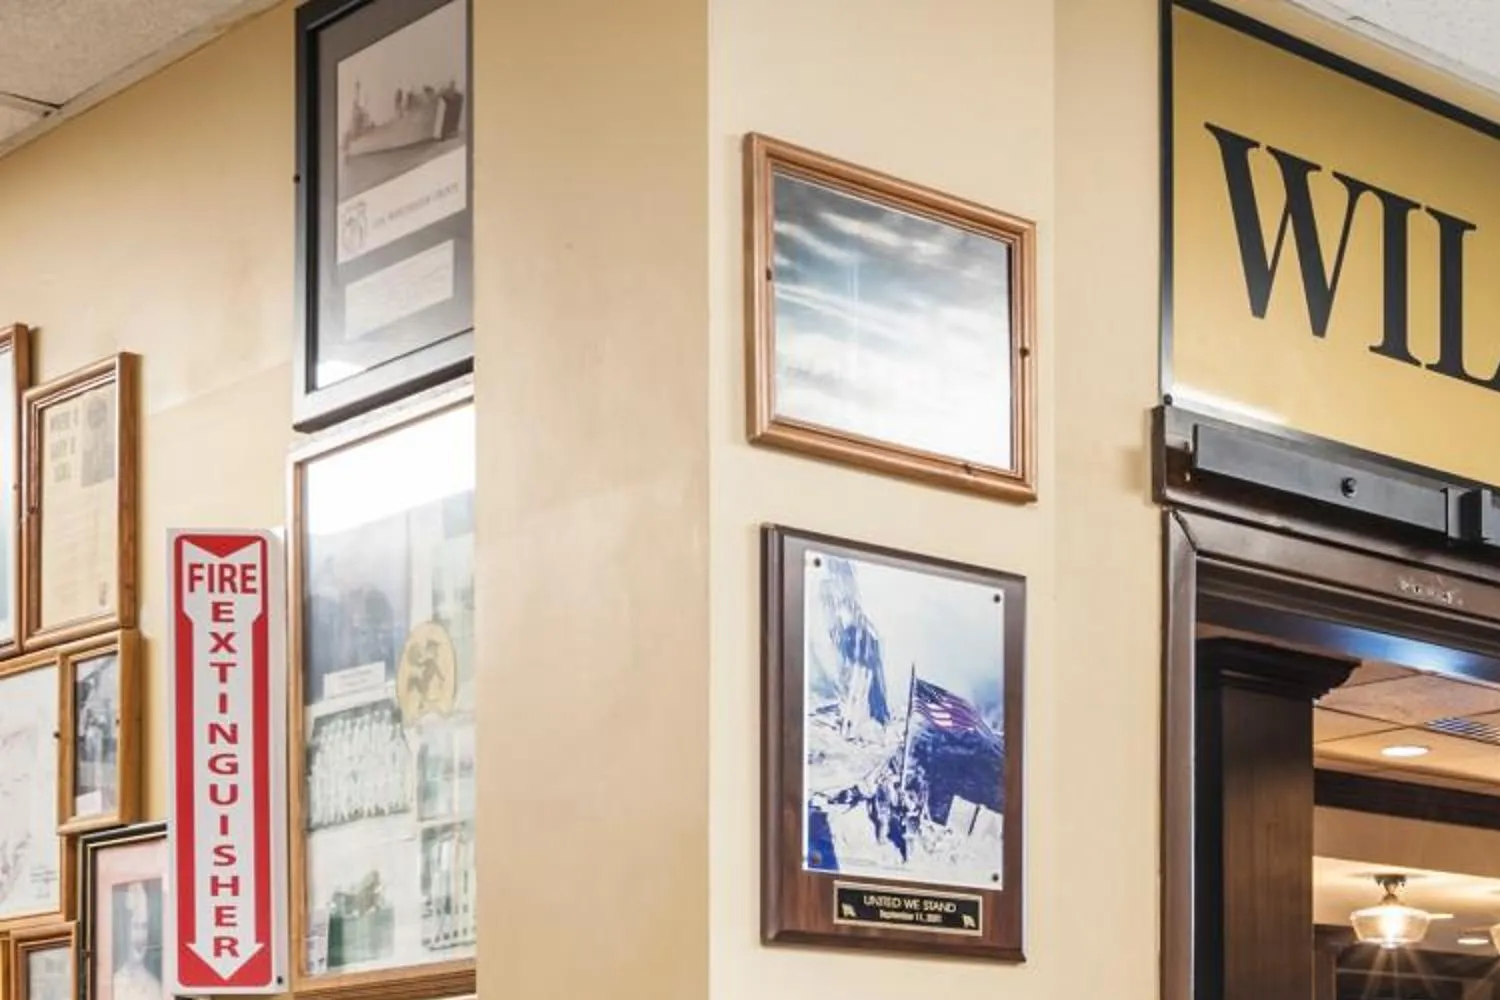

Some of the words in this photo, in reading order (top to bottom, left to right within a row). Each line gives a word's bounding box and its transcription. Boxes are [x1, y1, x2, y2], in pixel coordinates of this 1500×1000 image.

[188, 563, 257, 595] FIRE
[208, 601, 240, 958] EXTINGUISHER
[864, 895, 902, 908] UNITED
[904, 899, 921, 910] WE
[923, 900, 956, 913] STAND
